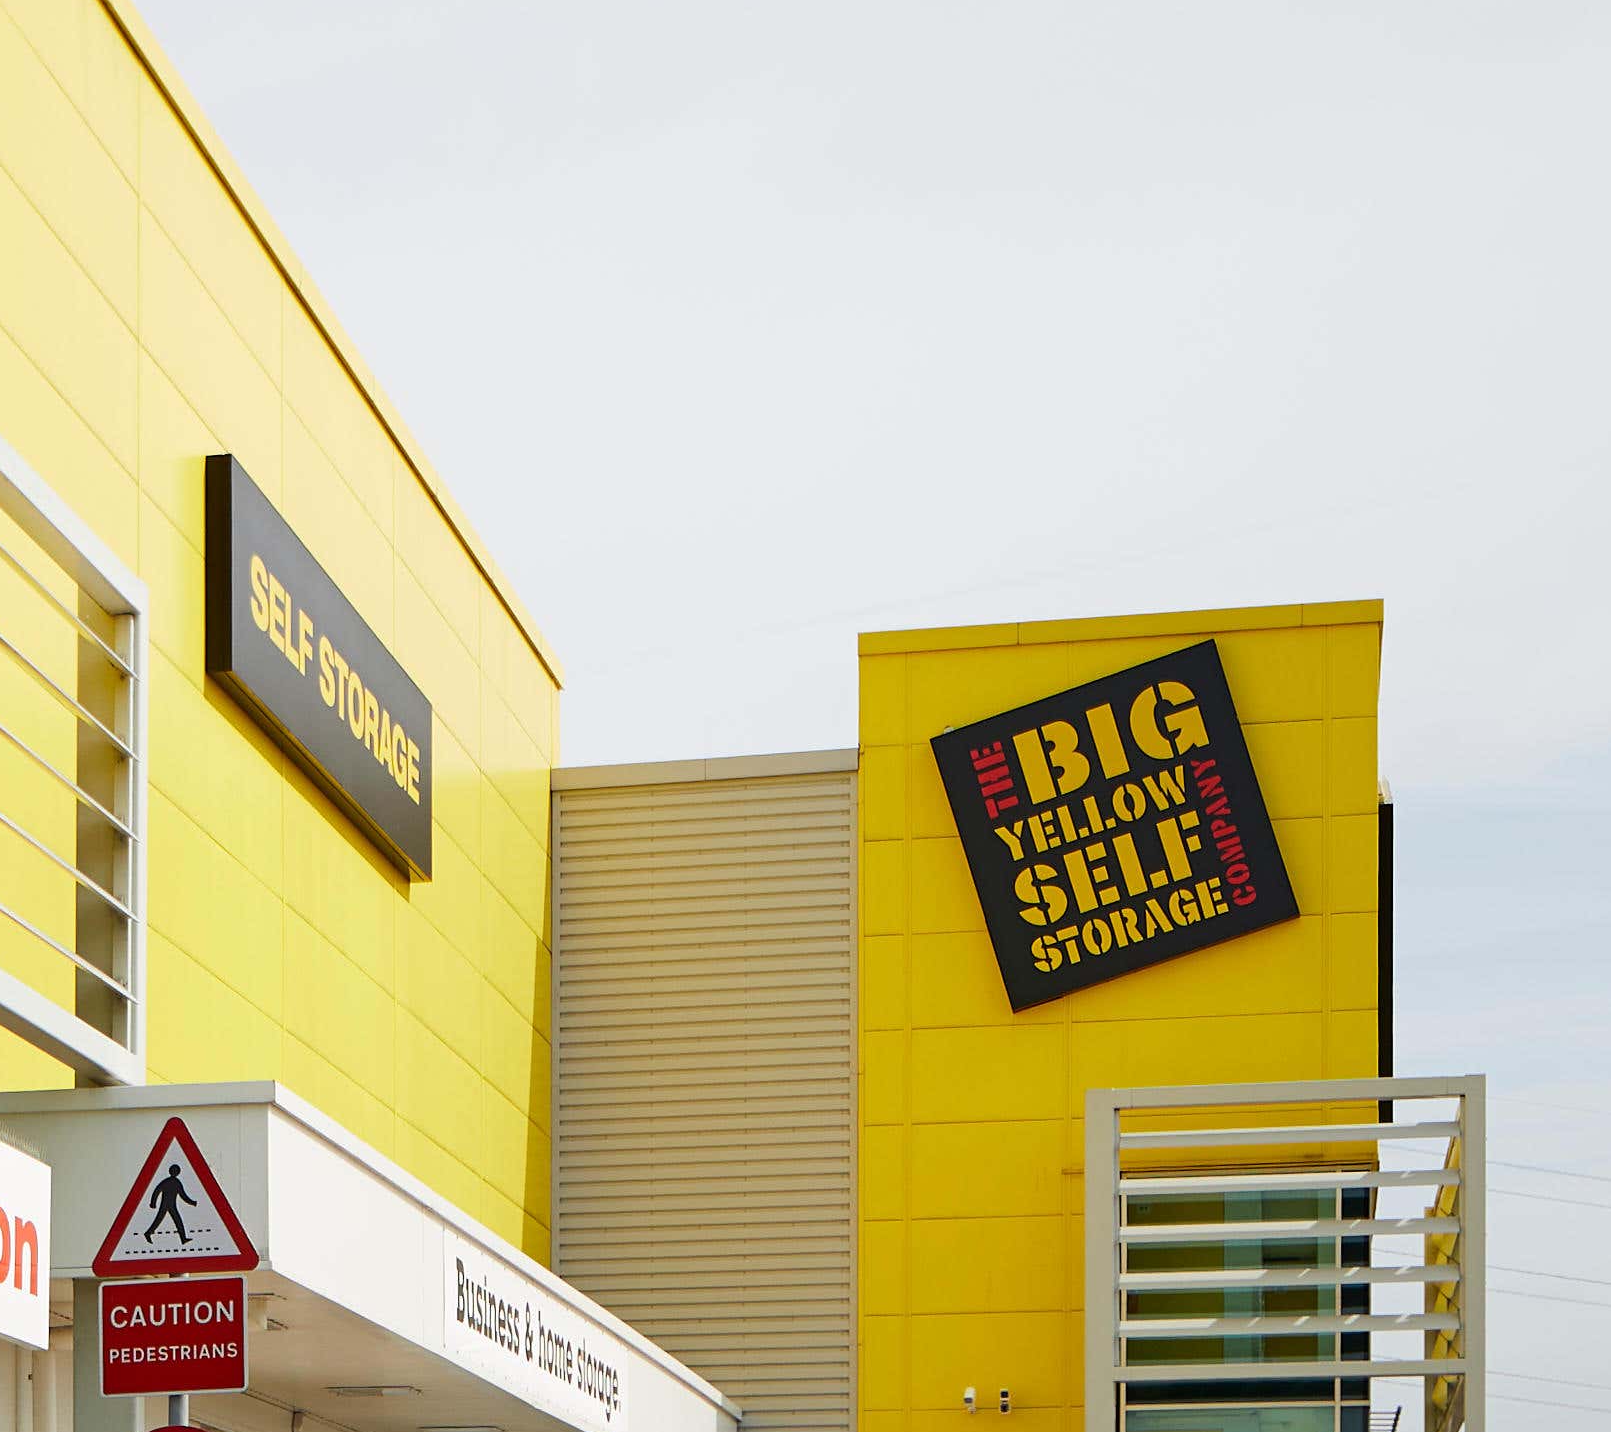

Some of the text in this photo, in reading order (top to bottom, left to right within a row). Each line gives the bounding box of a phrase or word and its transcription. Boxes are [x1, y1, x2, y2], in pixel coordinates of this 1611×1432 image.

[250, 554, 420, 805] SELF STORAGE
[970, 740, 1019, 820] THE
[1012, 681, 1210, 805] BIG
[994, 765, 1186, 862] YELLOW
[1190, 757, 1256, 907] COMPANY
[1014, 810, 1202, 926] SELF
[1030, 877, 1230, 973] STORAGE
[109, 1341, 239, 1365] PEDESTRIANS
[110, 1300, 236, 1330] CAUTION
[456, 1256, 621, 1422] Business & home storage.
